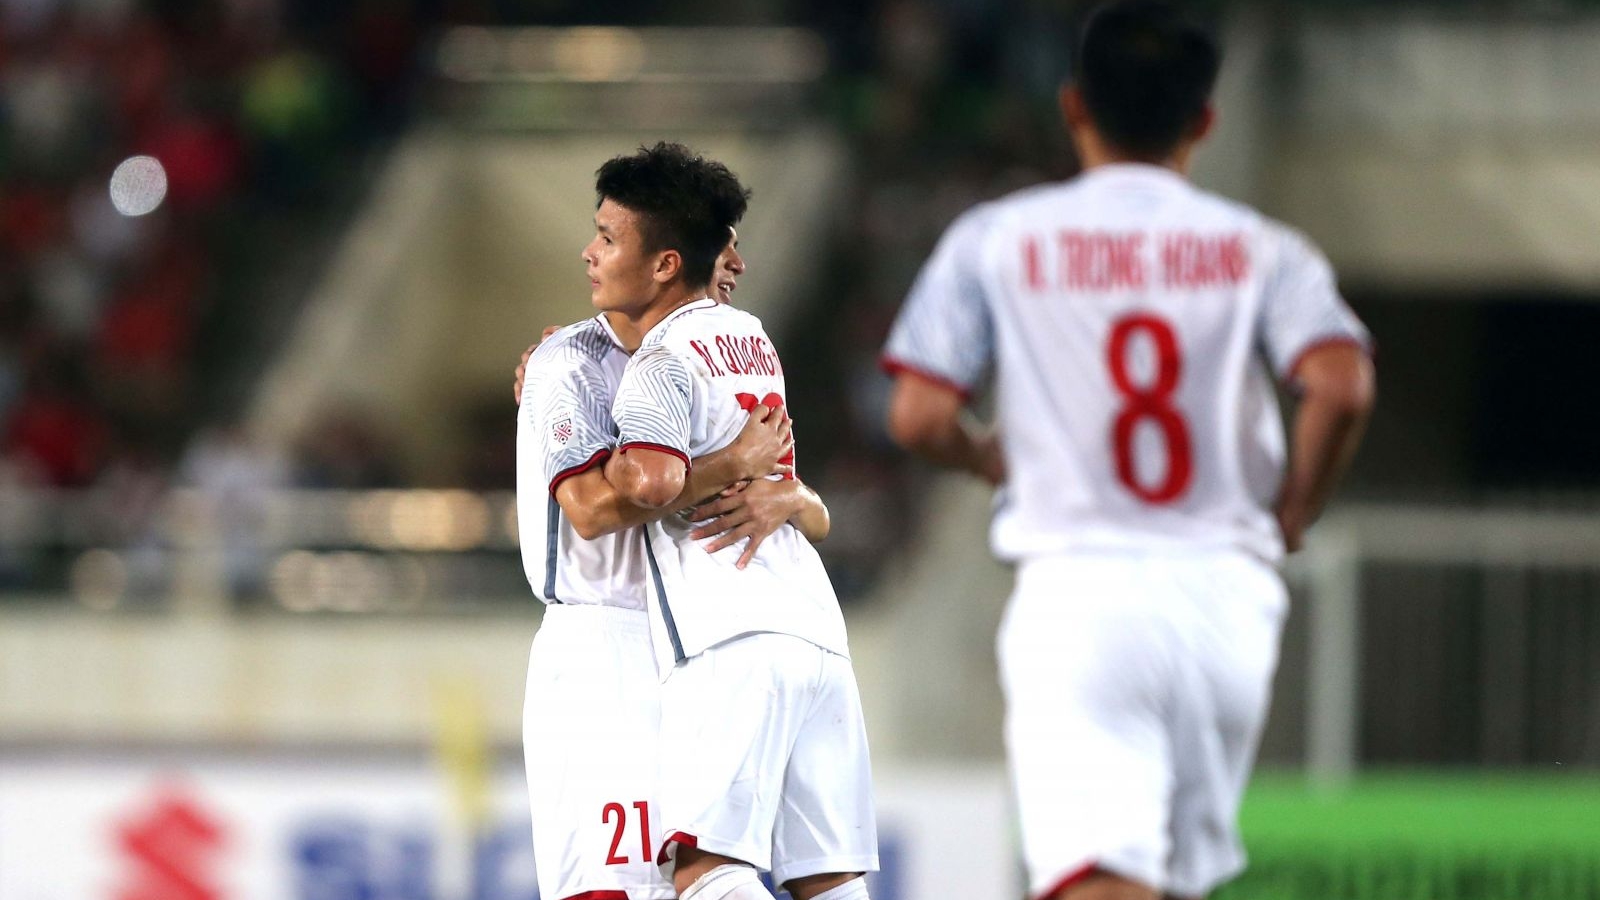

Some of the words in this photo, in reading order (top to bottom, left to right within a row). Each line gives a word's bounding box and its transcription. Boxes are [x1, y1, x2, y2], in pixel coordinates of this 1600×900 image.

[690, 340, 726, 377] N.
[715, 334, 776, 377] QUANG
[1106, 311, 1194, 507] 8
[602, 801, 652, 865] 21
